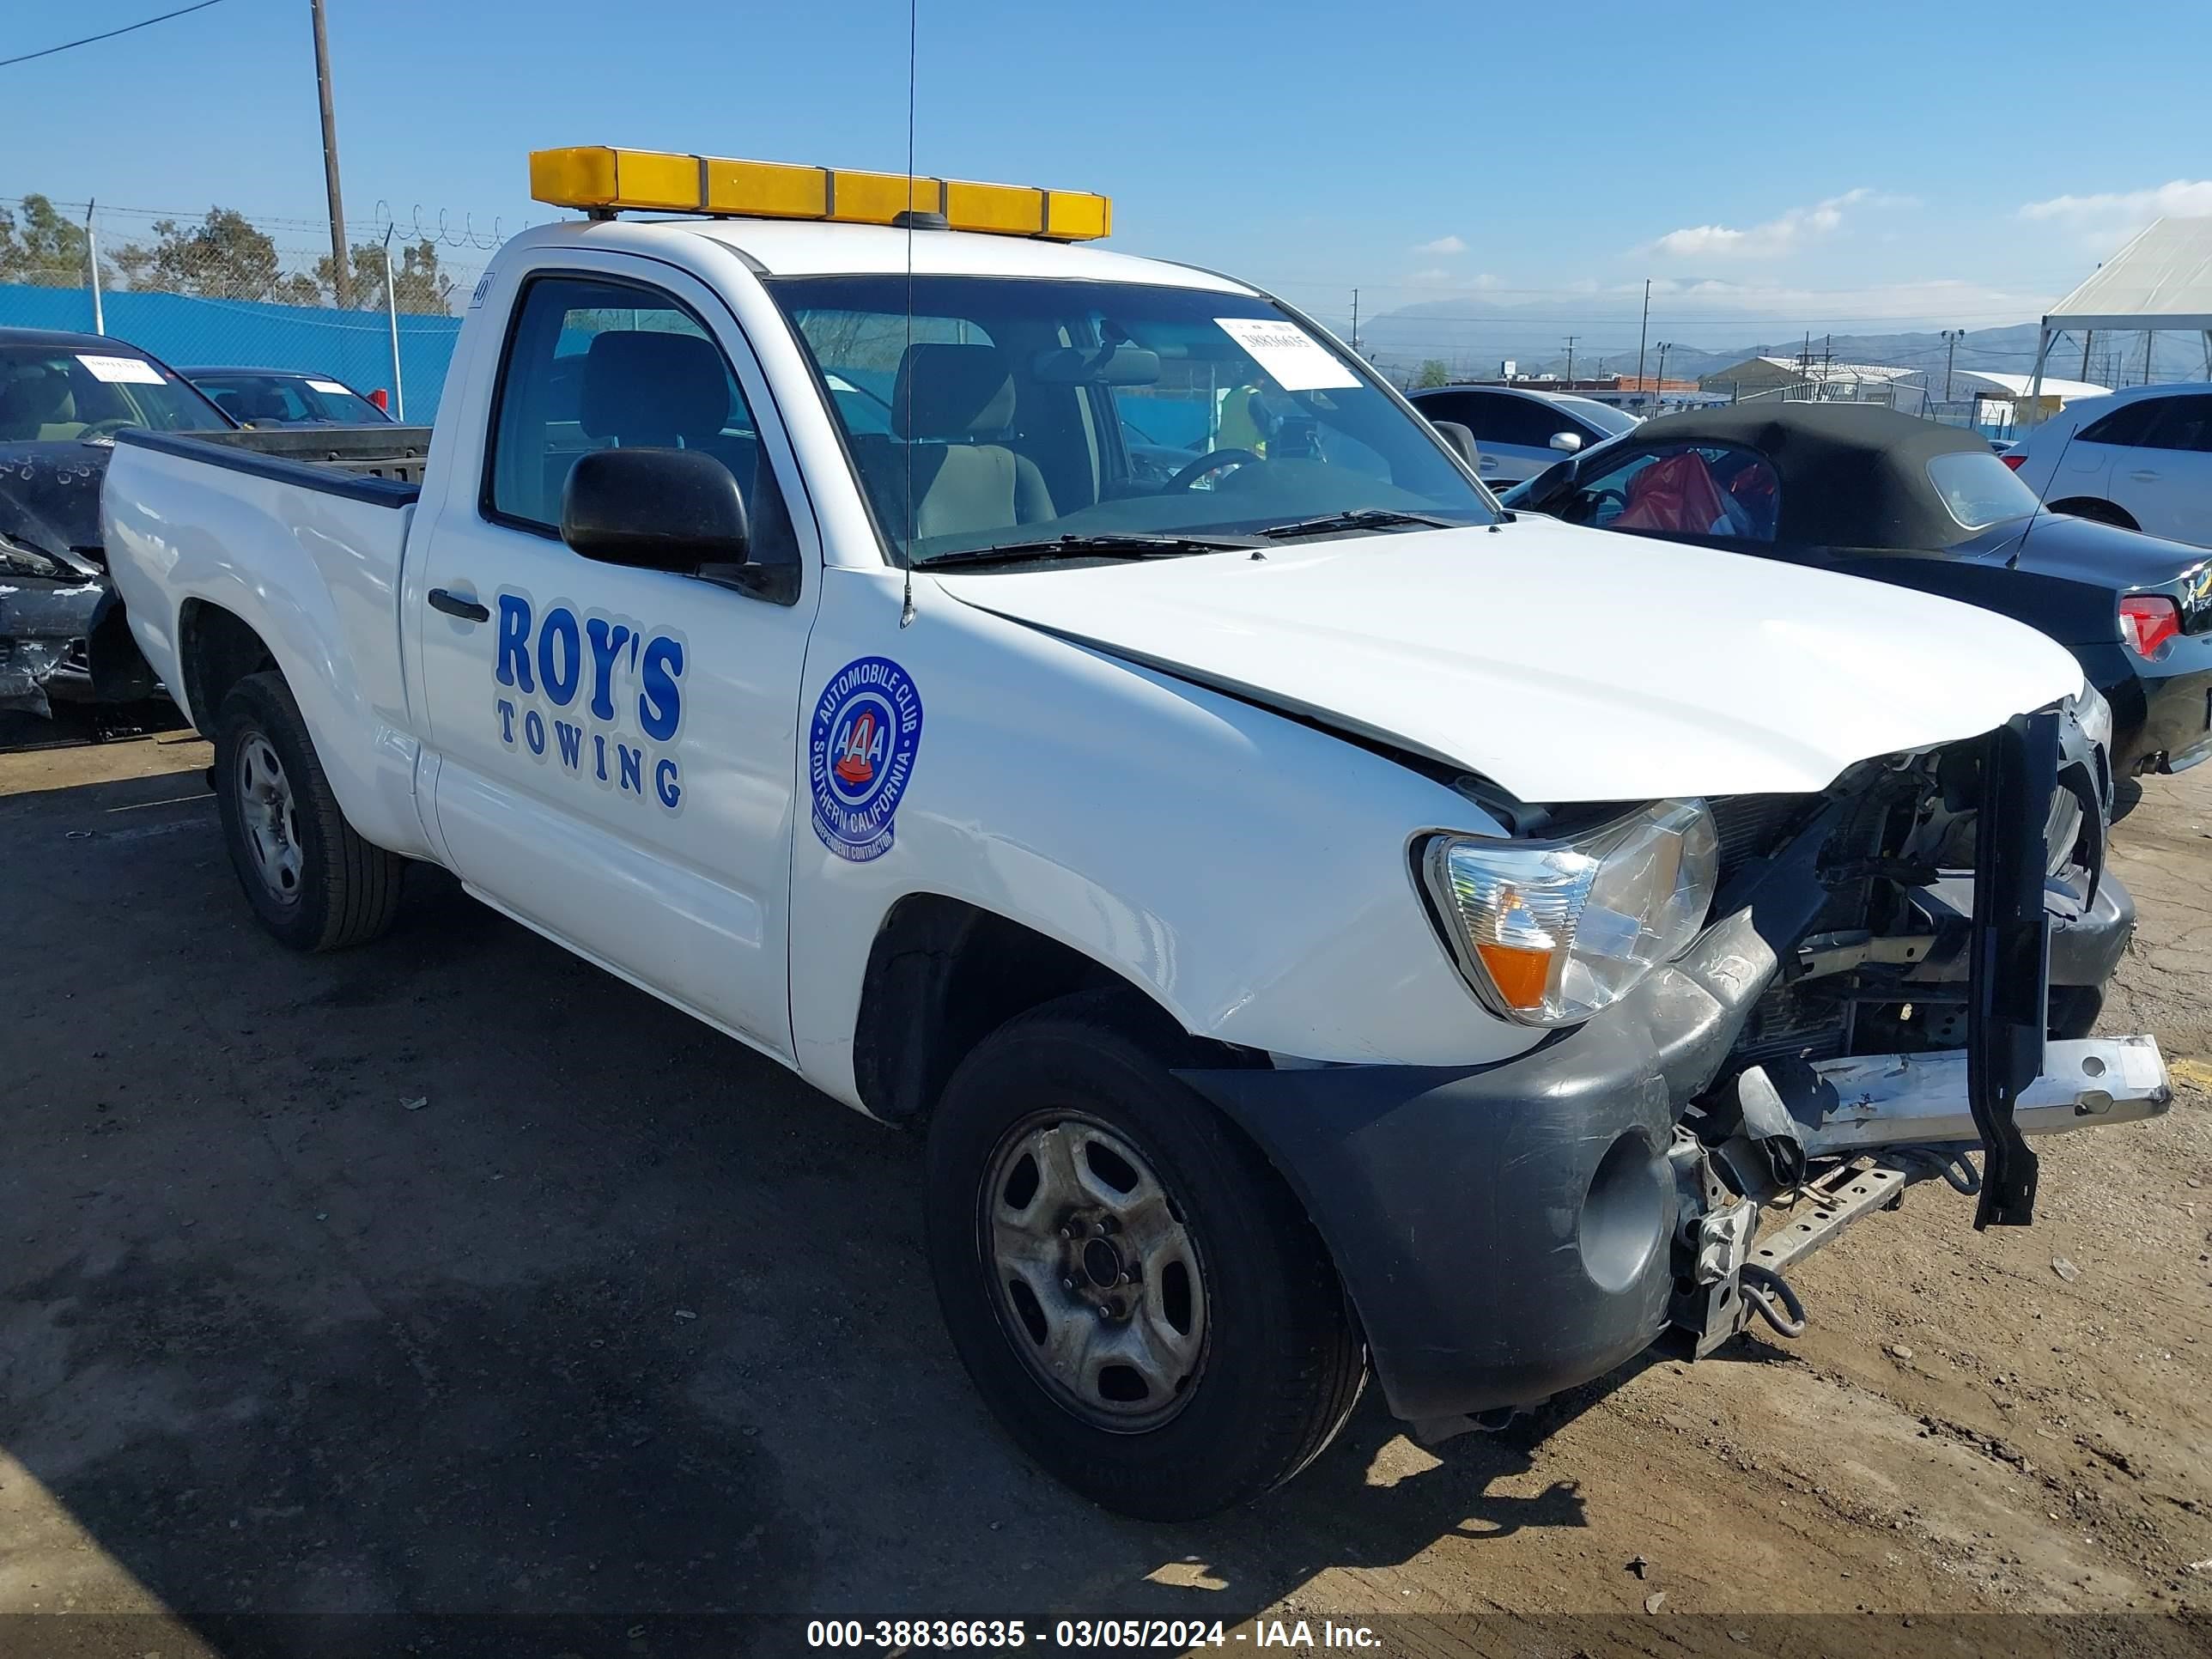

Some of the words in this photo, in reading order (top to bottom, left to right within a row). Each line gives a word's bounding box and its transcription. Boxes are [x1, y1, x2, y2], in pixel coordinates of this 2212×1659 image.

[1242, 334, 1311, 348] 38836635
[495, 593, 684, 742] ROY'S
[818, 664, 900, 725] AUTOMOBILE
[896, 684, 917, 733] CLUB
[497, 699, 681, 808] TOWING
[835, 719, 885, 766] AAA
[812, 740, 848, 831] SOUTHERN
[850, 751, 911, 833] CALIFORNIA
[812, 813, 850, 859] INDEPENDENT
[851, 830, 893, 860] CONTRACTOR
